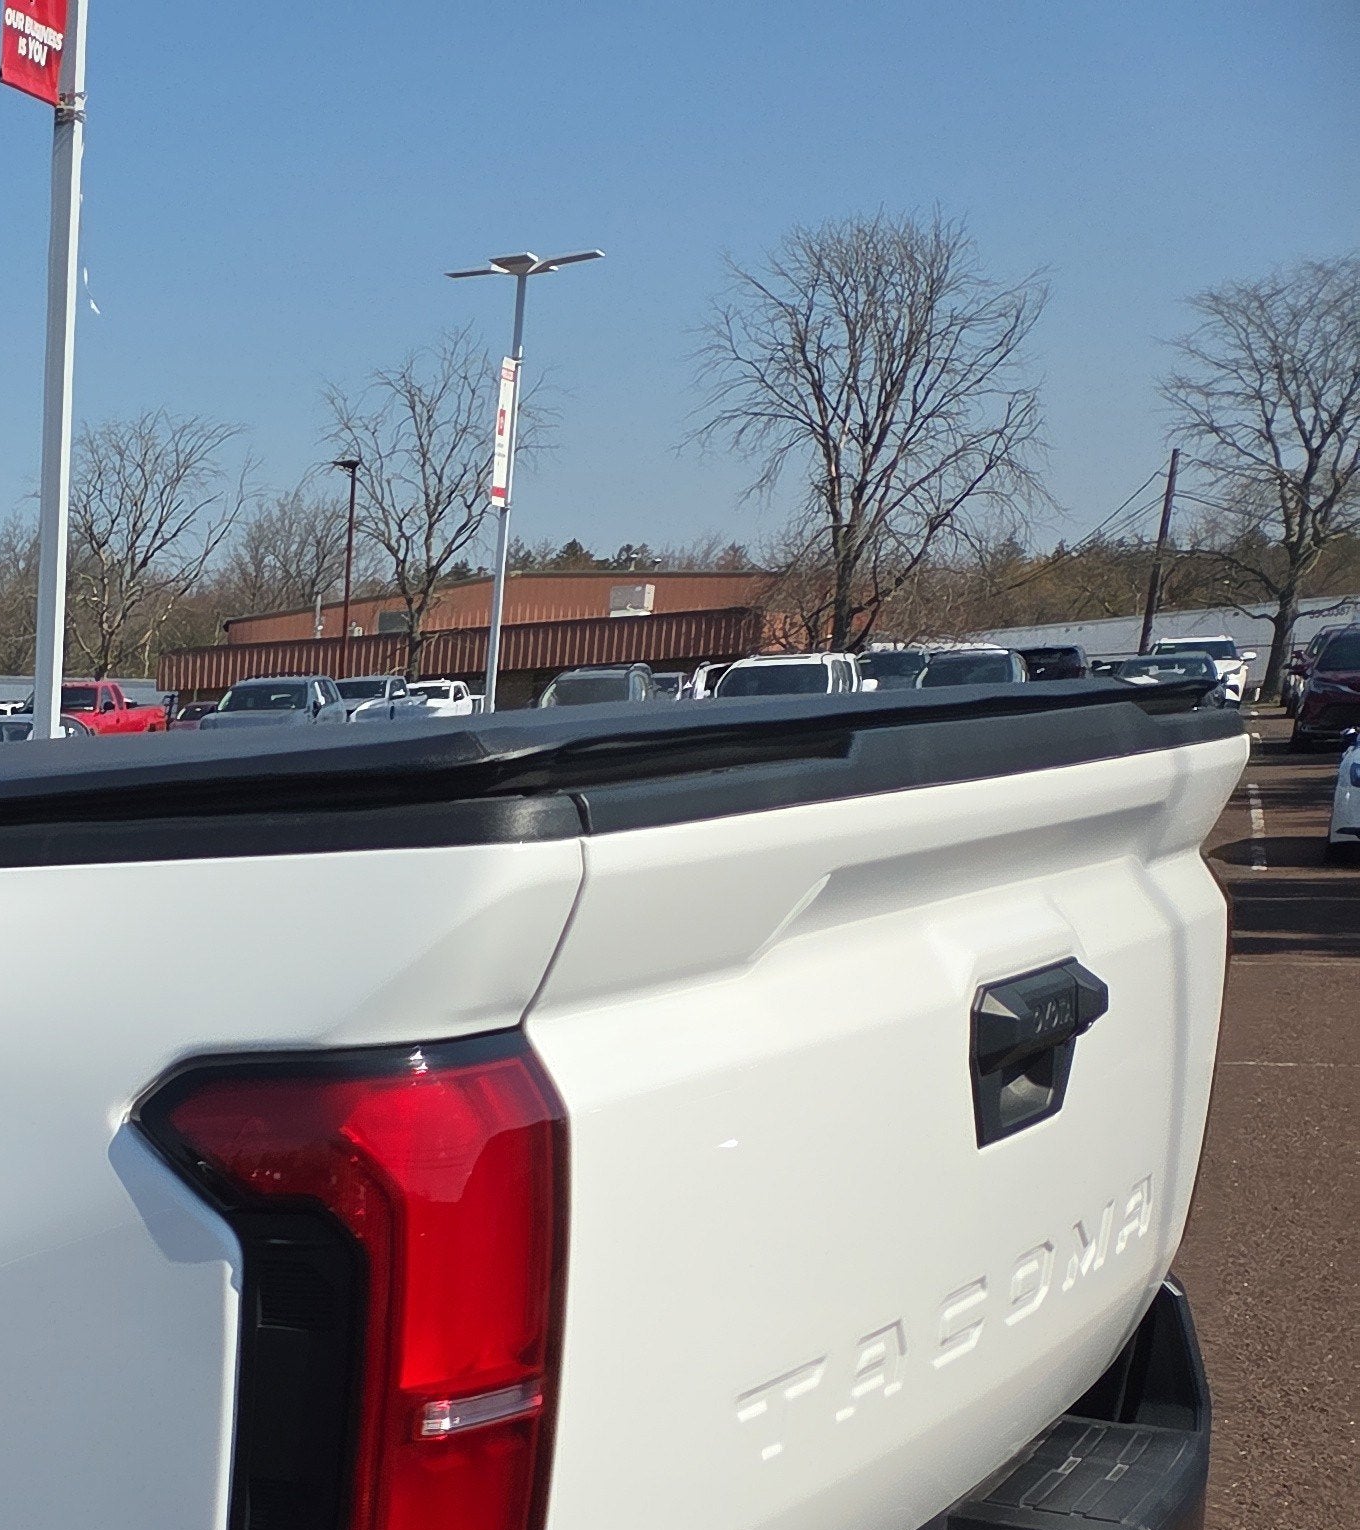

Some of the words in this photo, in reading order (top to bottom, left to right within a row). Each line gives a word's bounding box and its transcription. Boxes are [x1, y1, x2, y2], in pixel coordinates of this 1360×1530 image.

[18, 36, 26, 55] IS
[28, 37, 48, 66] YOU
[735, 1173, 1155, 1460] TACOMA
